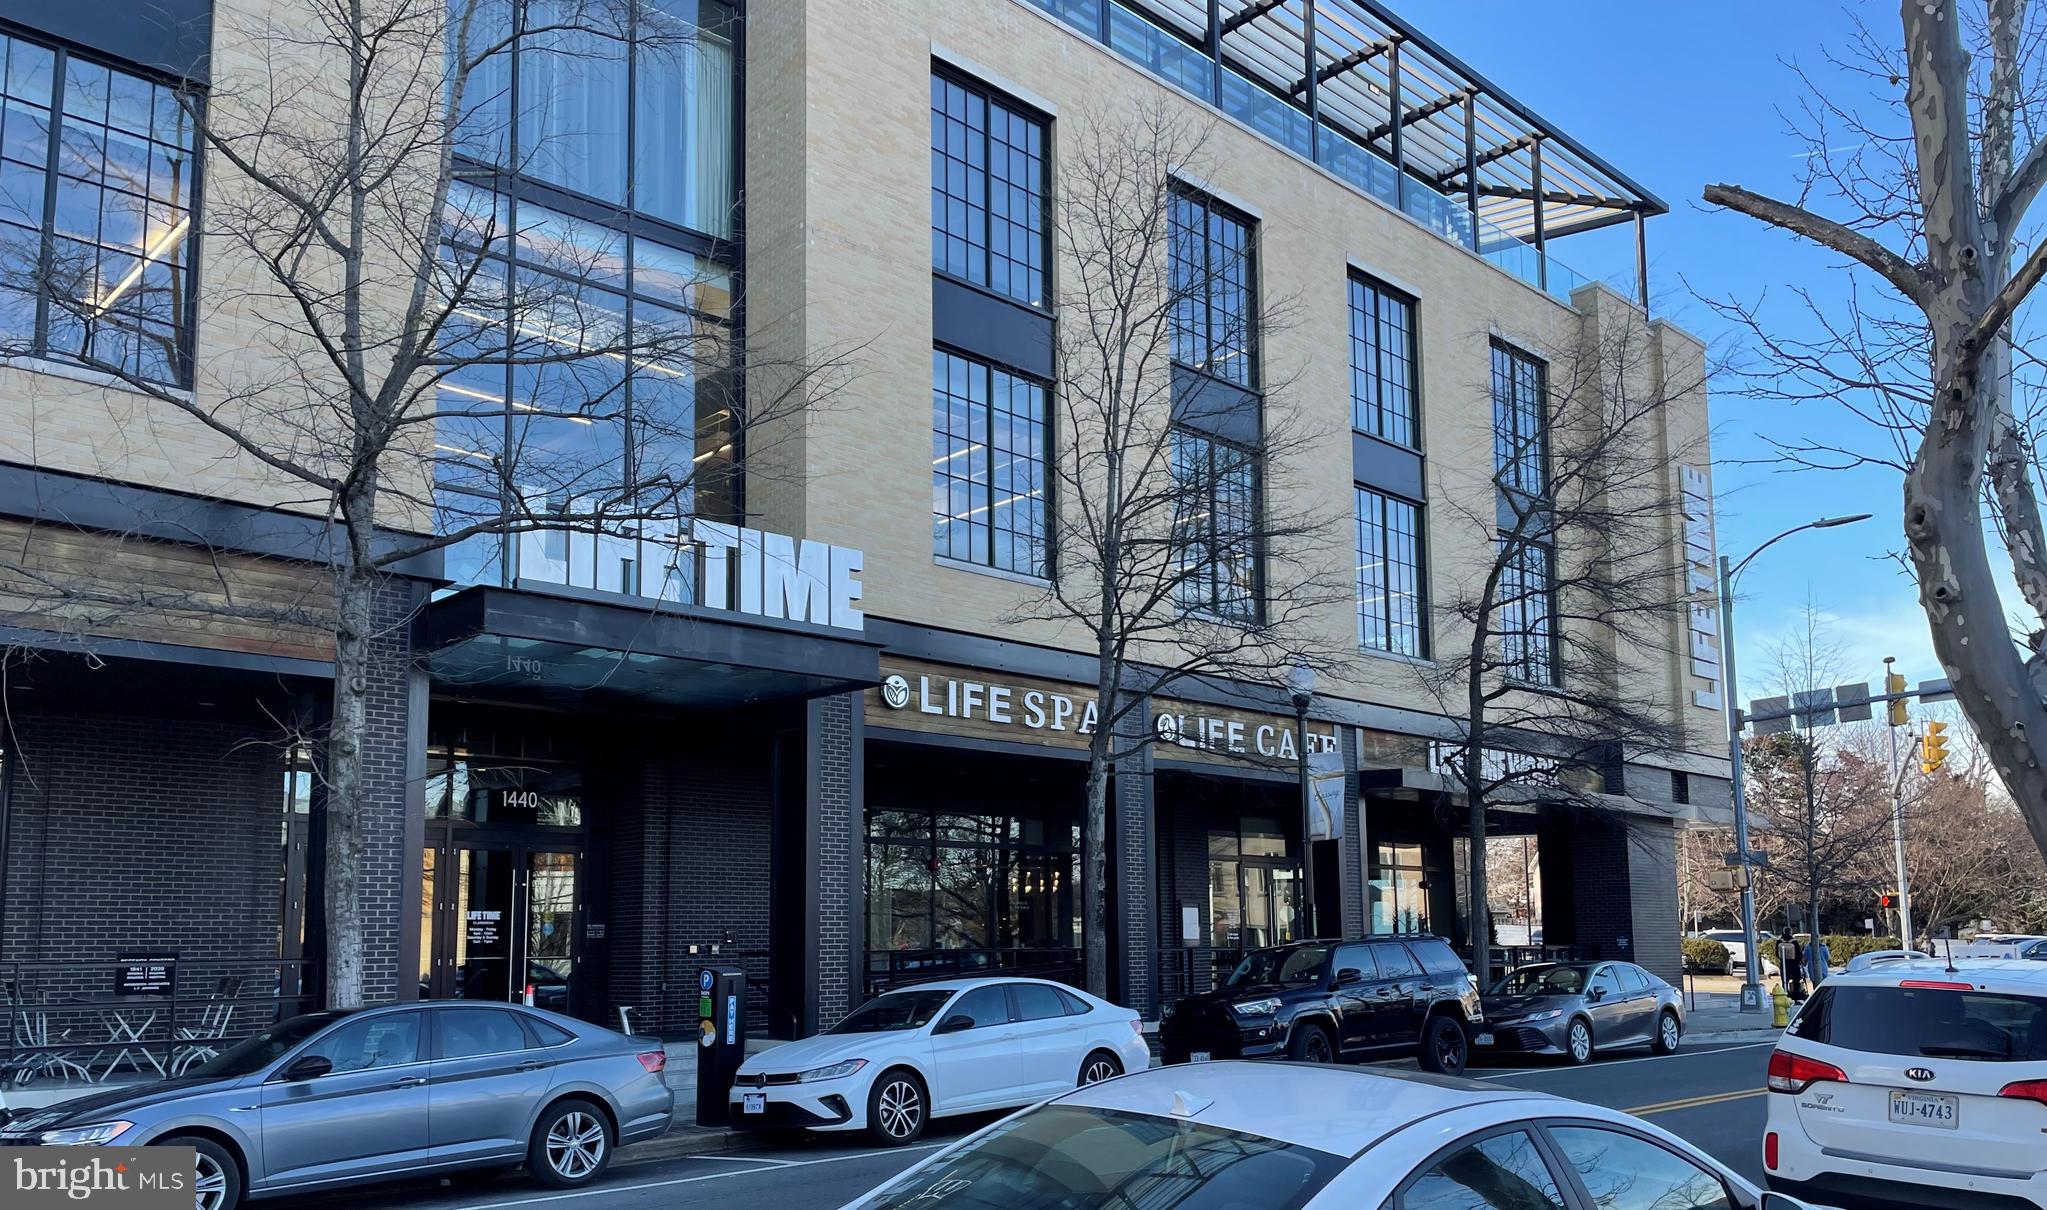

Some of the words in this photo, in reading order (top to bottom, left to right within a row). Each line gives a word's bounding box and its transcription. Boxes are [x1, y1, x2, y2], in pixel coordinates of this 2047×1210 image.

[519, 484, 690, 606] LIFE
[693, 518, 864, 631] TIME
[920, 675, 1011, 724] LIFE
[1024, 691, 1099, 734] SPA
[1178, 714, 1246, 753] LIFE
[502, 790, 538, 808] 1440
[466, 911, 482, 920] LIFE
[482, 911, 501, 920] TIME
[1909, 1069, 1931, 1079] KIA
[1907, 1094, 1939, 1103] VIRGINIA
[1893, 1100, 1952, 1120] WUJ-4743
